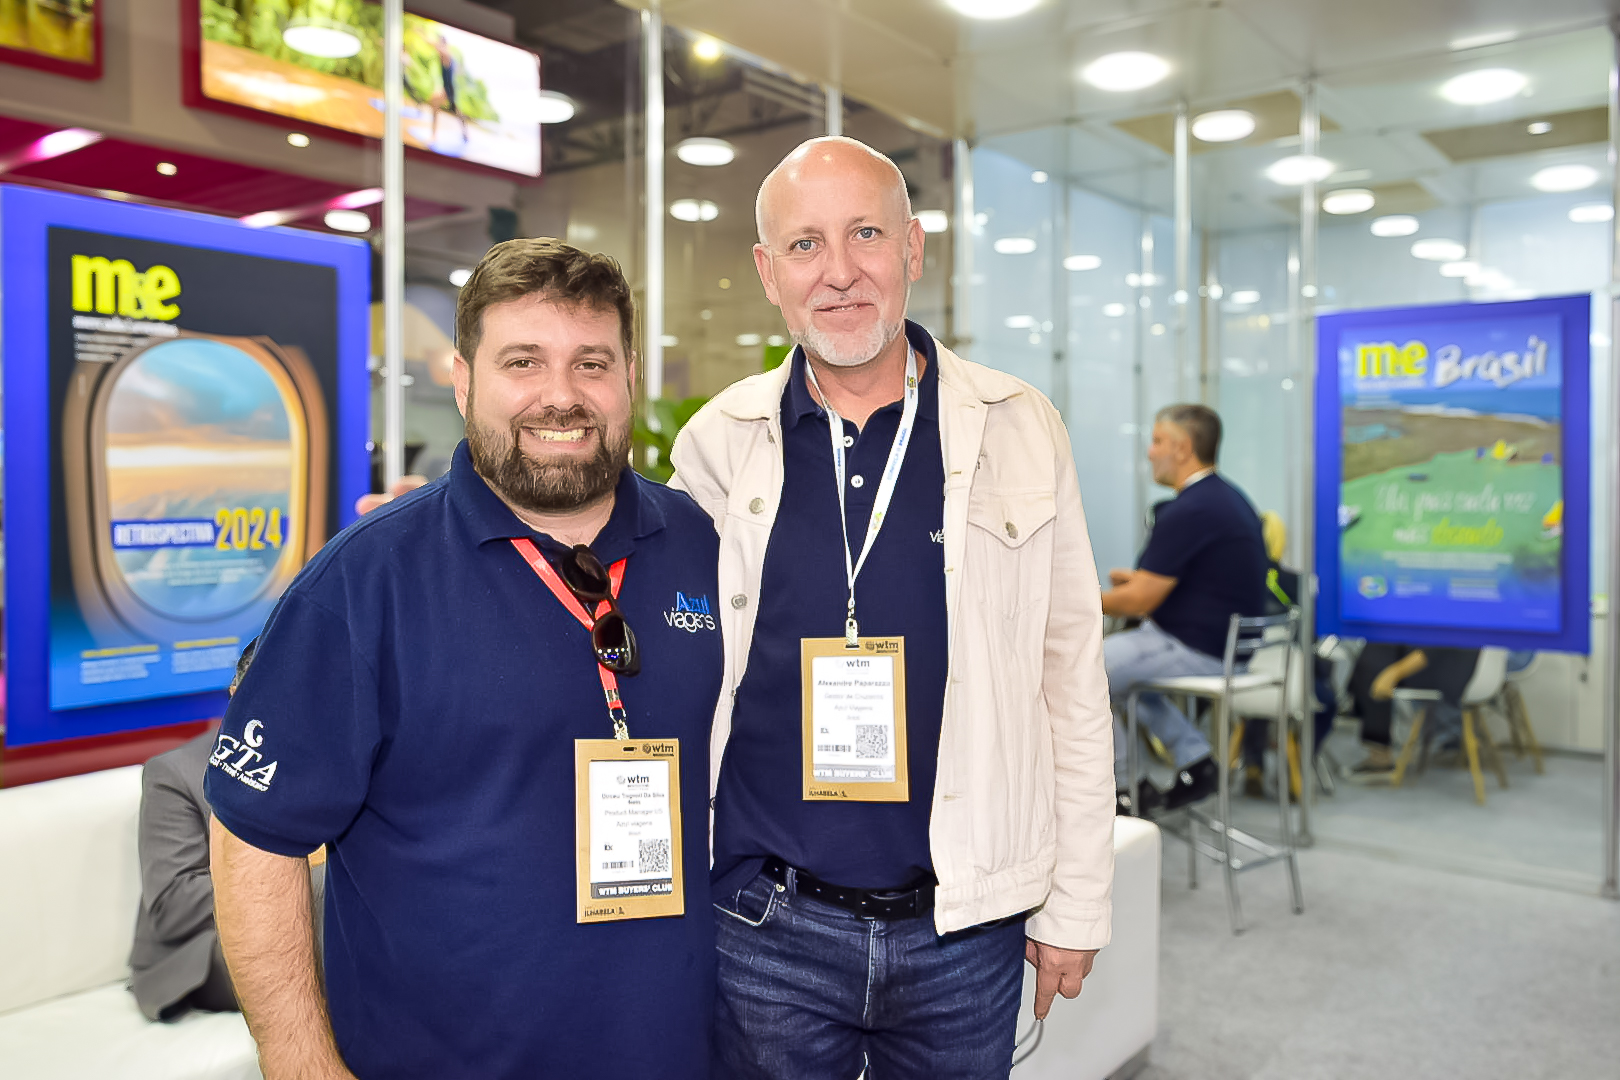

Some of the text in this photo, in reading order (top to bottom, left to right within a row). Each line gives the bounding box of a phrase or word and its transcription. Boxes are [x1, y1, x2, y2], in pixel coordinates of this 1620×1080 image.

[1434, 334, 1548, 389] Brasil
[215, 506, 283, 551] 2024
[846, 658, 870, 668] wtm
[213, 733, 278, 786] GTA
[652, 742, 674, 753] wtm
[627, 774, 650, 784] wtm
